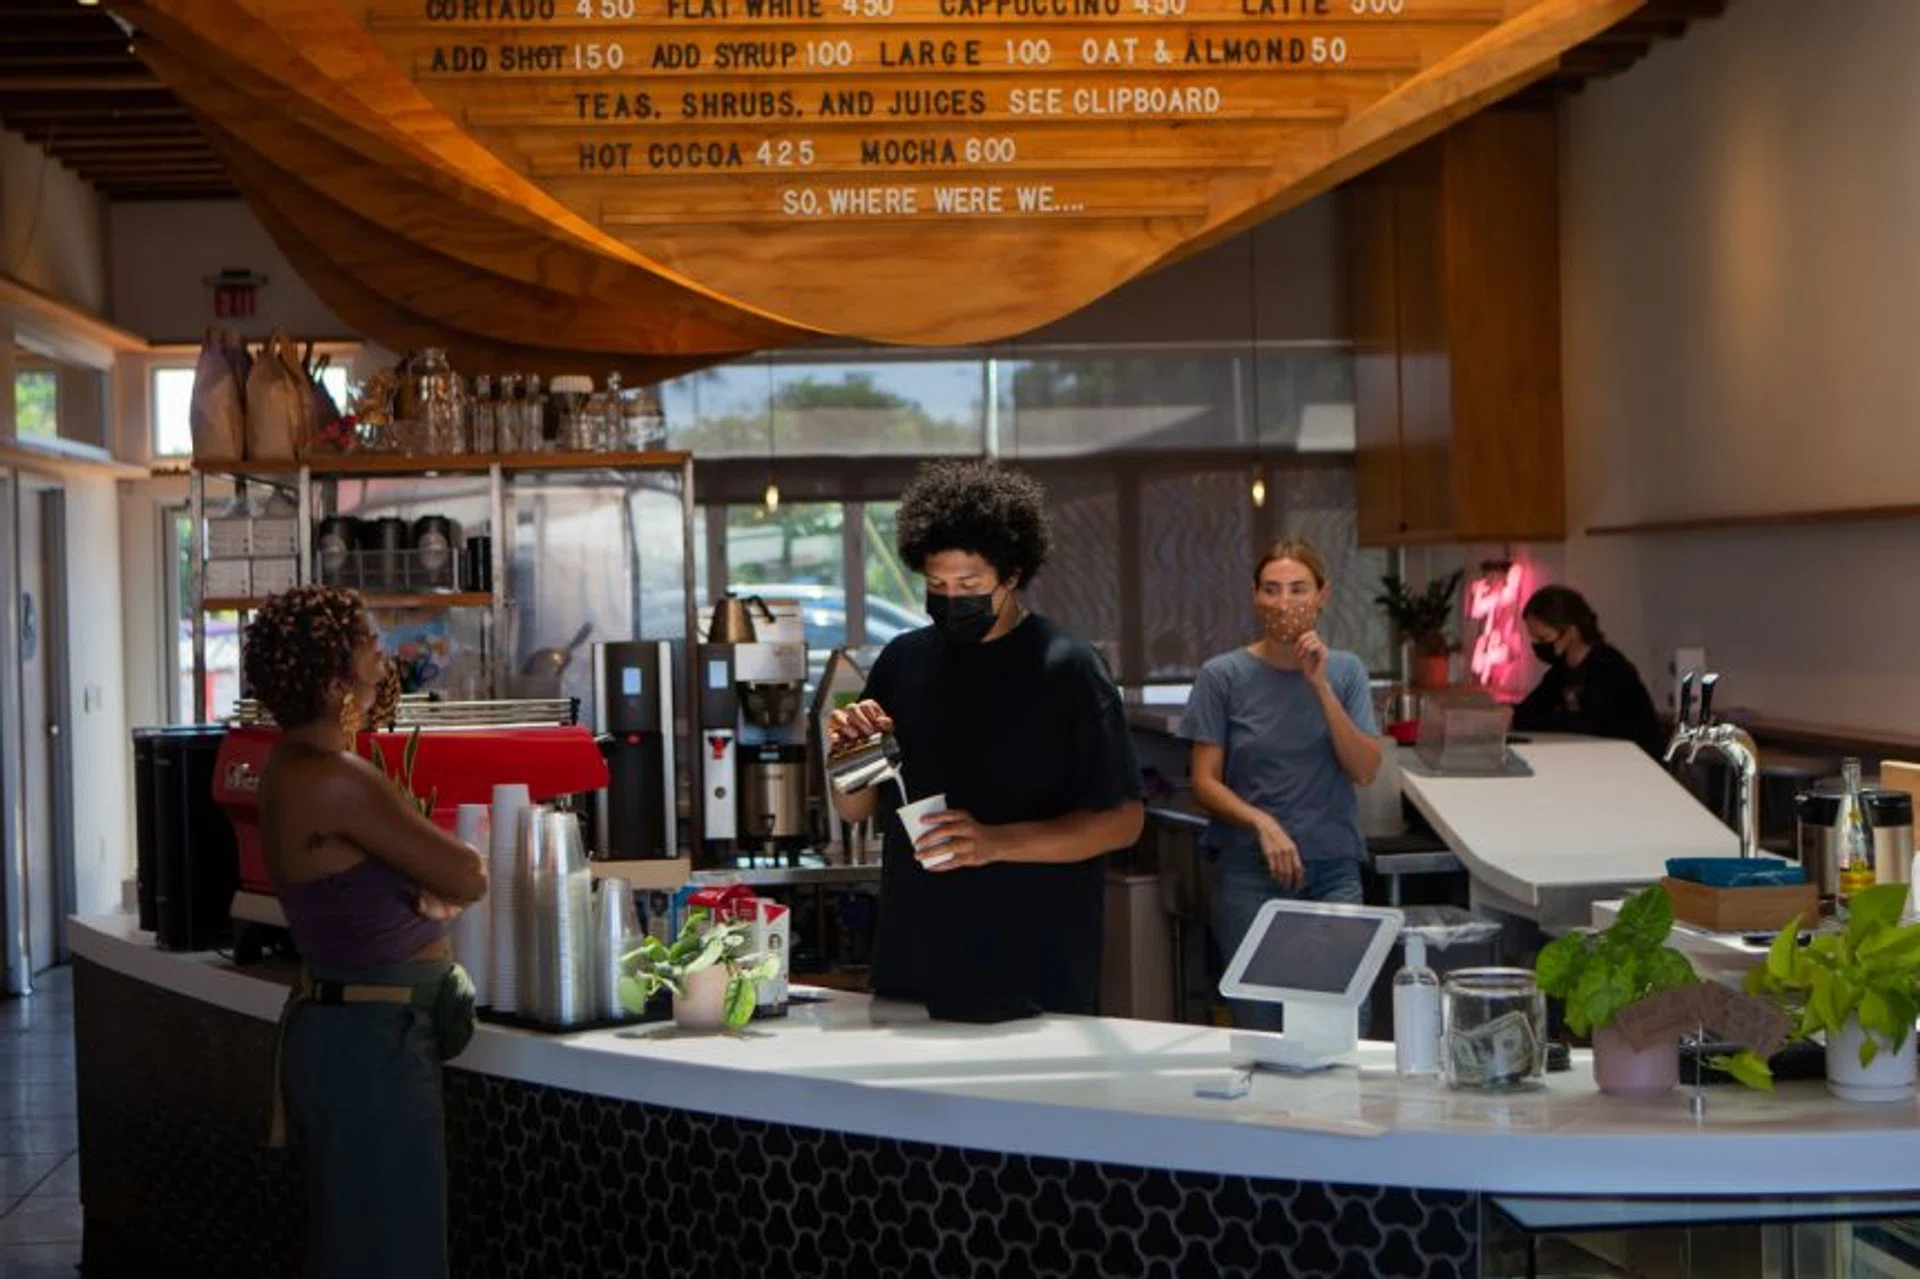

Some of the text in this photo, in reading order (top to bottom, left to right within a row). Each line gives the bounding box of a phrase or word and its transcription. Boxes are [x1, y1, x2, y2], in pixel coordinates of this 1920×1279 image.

[425, 0, 555, 20] CORTADO
[576, 0, 634, 19] 450
[667, 0, 729, 18] FLAT
[745, 0, 822, 18] WHITE
[842, 0, 895, 17] 450
[431, 37, 1347, 71] ADD SHOT 150 ADD SYRUP 100 LARGE 100 OAT & ALMOND 50
[818, 90, 874, 117] AND
[888, 89, 986, 116] JUICES
[1008, 88, 1064, 115] SEE
[1073, 86, 1222, 114] CLIPBOARD
[578, 137, 1017, 169] HOT COCOA 425 MOCHA 600
[827, 186, 918, 215] WHERE
[933, 186, 1003, 214] WERE
